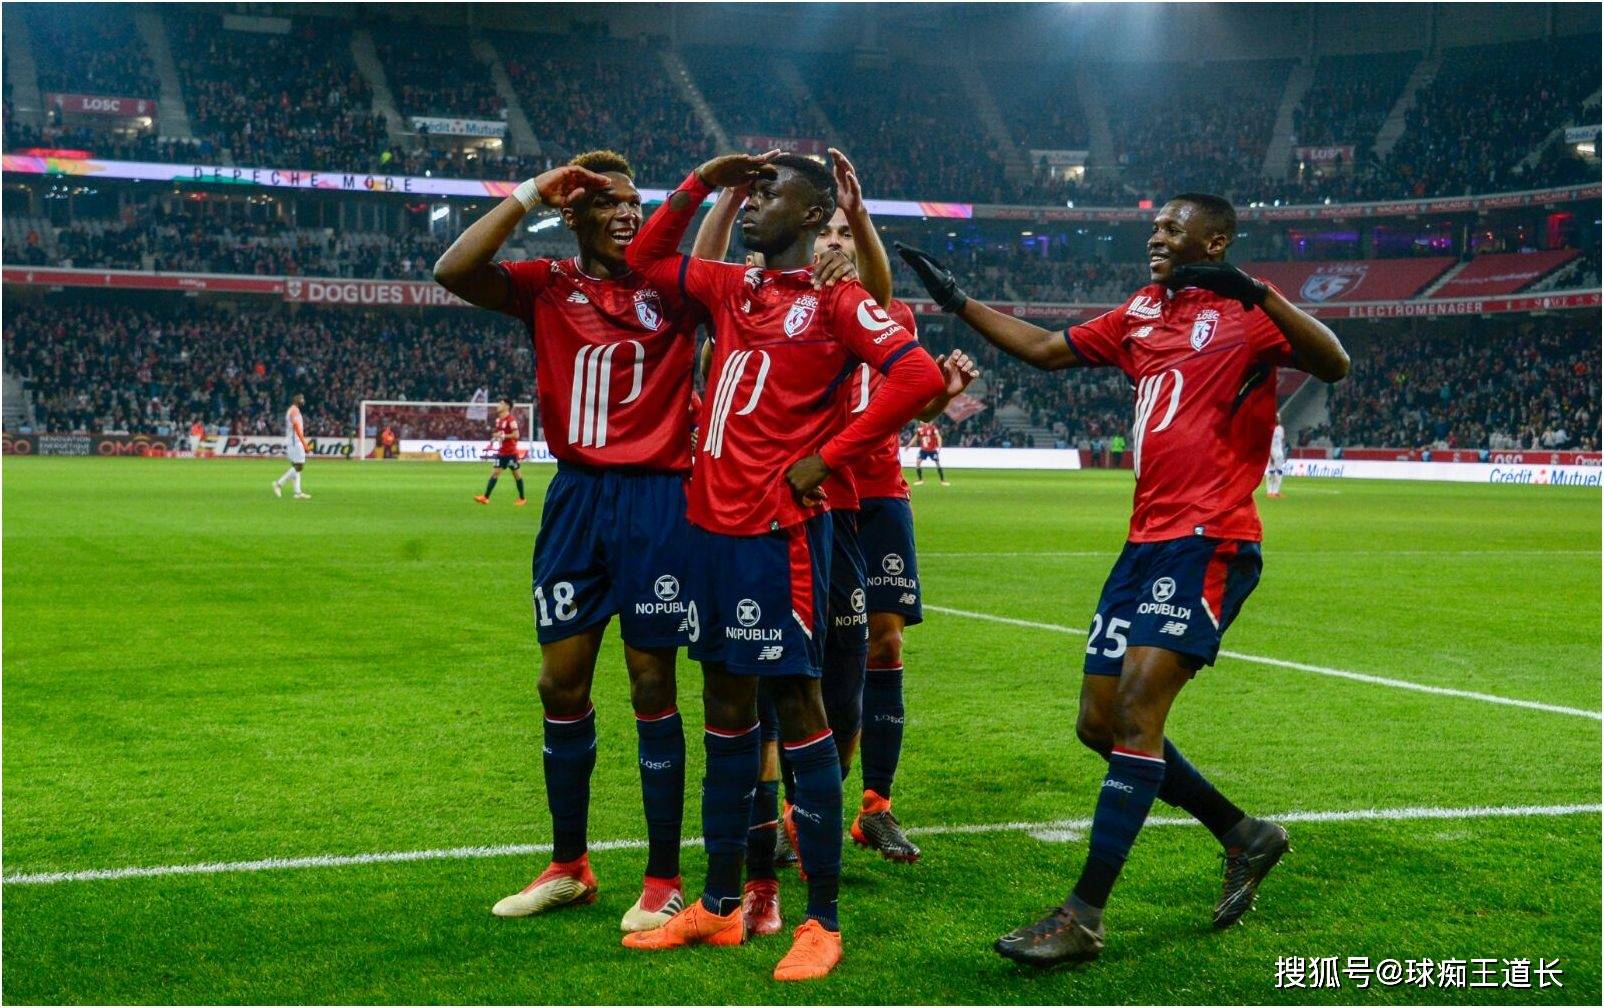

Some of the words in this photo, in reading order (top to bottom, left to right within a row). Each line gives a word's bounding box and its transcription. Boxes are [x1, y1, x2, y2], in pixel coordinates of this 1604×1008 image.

[82, 98, 120, 111] LOSC
[1311, 148, 1338, 159] LOS
[192, 166, 319, 187] DEPECHE
[343, 177, 412, 191] MODE
[308, 283, 404, 304] DOGUES
[410, 287, 462, 305] VIRA
[1349, 302, 1483, 319] ELECTROMENAGER
[873, 324, 906, 344] boulan
[305, 438, 354, 455] Auto
[1490, 454, 1523, 464] OSC
[1490, 468, 1533, 484] Crédit
[1550, 470, 1602, 487] Mutuel
[866, 577, 881, 587] NO
[534, 581, 577, 627] 18
[635, 603, 654, 614] NO
[655, 601, 688, 614] PUBL
[835, 616, 852, 626] NO
[852, 613, 868, 625] PUB
[737, 628, 782, 641] PUBLIK
[1086, 613, 1132, 659] 25
